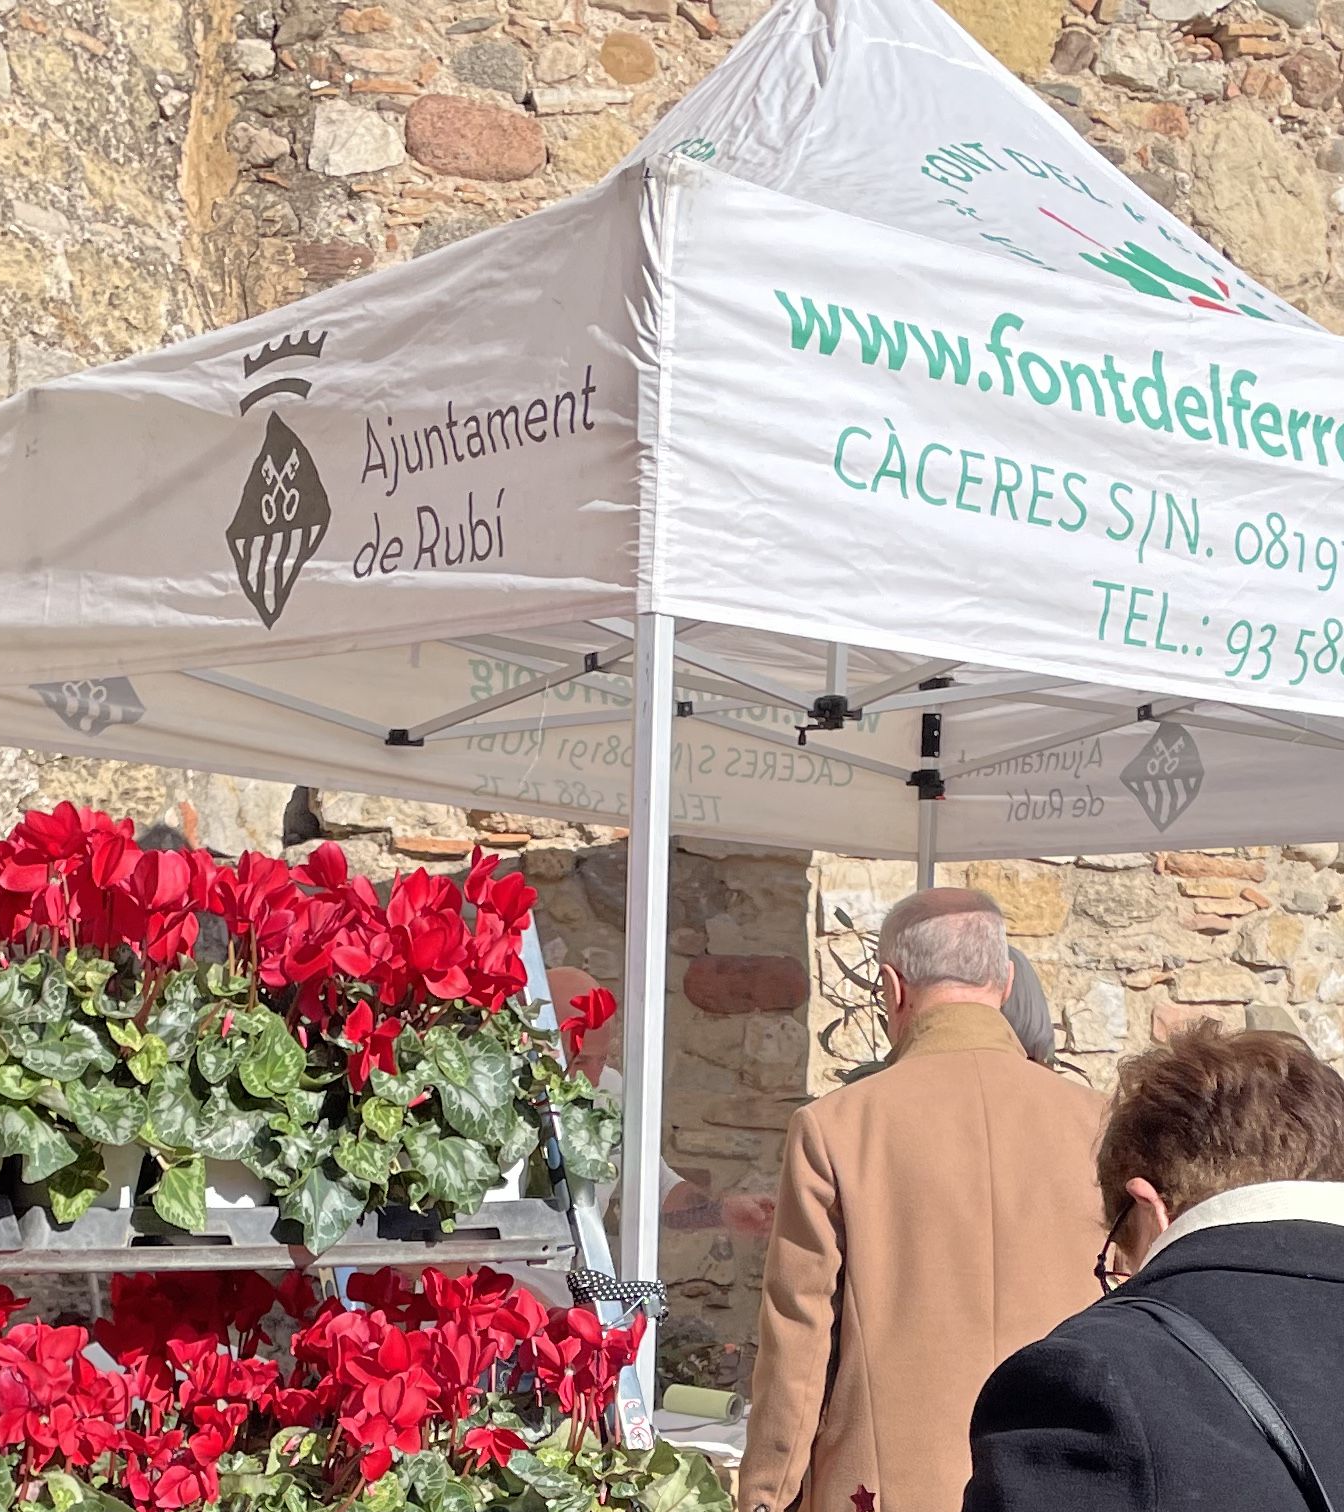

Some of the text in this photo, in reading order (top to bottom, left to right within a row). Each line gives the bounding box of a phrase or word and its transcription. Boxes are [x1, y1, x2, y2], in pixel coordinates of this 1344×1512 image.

[921, 142, 1008, 194] FONT
[361, 364, 596, 497] Ajuntament
[353, 487, 506, 579] de Rubí
[832, 417, 1088, 533] CÀCERES
[1106, 482, 1214, 564] S/N.
[1225, 619, 1276, 681] 93
